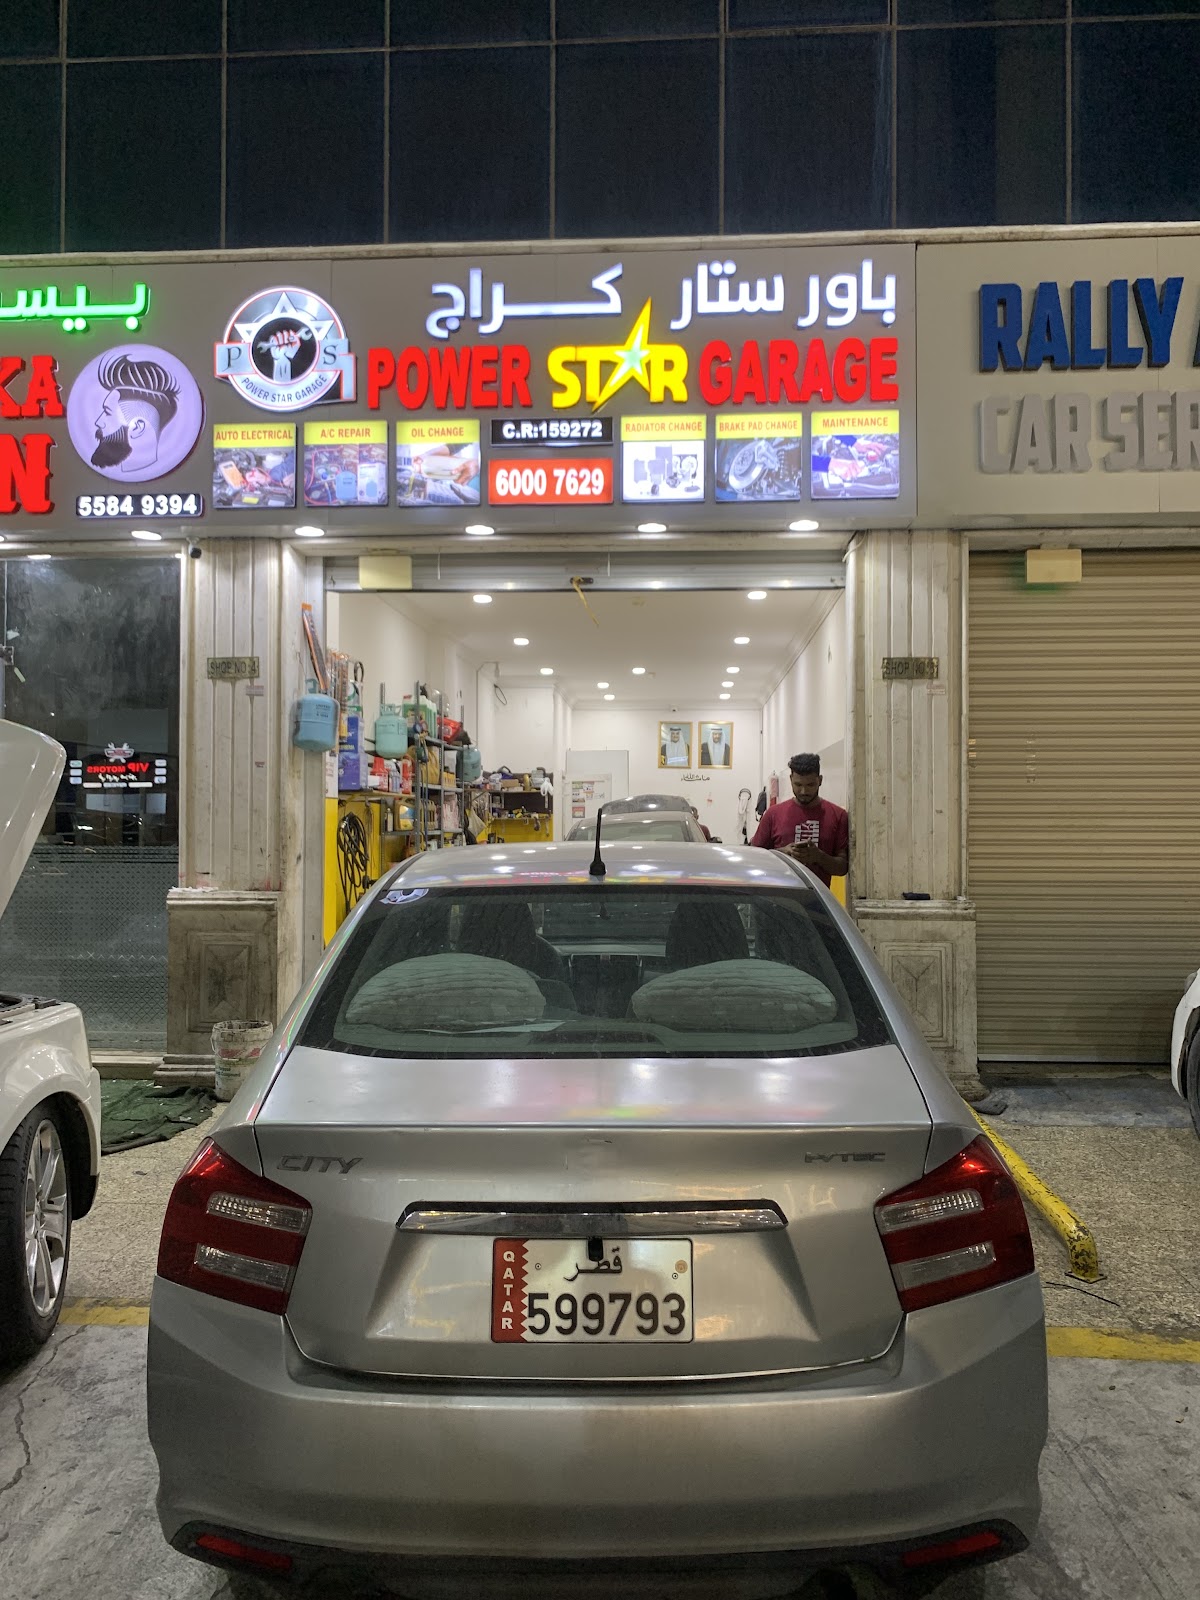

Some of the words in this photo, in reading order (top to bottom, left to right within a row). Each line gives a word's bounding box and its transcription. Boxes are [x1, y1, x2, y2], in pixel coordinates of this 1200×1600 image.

[425, 262, 623, 338] كراج
[670, 260, 785, 330] ستار
[797, 259, 897, 327] باور
[979, 277, 1184, 373] RALLY
[222, 347, 242, 372] P
[323, 345, 338, 366] S
[368, 345, 533, 409] POWER
[547, 297, 689, 415] STAR
[699, 337, 899, 405] GARAGE
[241, 377, 269, 400] POWER
[271, 393, 293, 403] STAR
[295, 375, 328, 401] GARAGE
[215, 430, 239, 441] AUTO
[241, 429, 294, 440] ELECTRICAL
[320, 428, 335, 438] A/C
[338, 427, 371, 438] REPAIR
[411, 428, 425, 438] OIL
[428, 427, 464, 437] CHANGE
[502, 420, 604, 439] C.R:159272
[625, 422, 666, 432] RADIATOR
[668, 421, 703, 431] CHANGE
[719, 421, 745, 432] BRAKE
[748, 421, 763, 431] PAD
[765, 420, 798, 430] CHANGE
[822, 416, 889, 428] MAINTENANCE
[980, 394, 1092, 474] CAR
[1103, 391, 1200, 473] SER
[495, 467, 547, 496] 6000
[553, 467, 605, 496] 7629
[78, 495, 134, 516] 5584
[141, 494, 197, 515] 9394
[277, 1155, 363, 1174] CITY
[563, 1246, 623, 1282] قطر
[501, 1250, 515, 1330] QATAR
[527, 1291, 686, 1336] 599793
